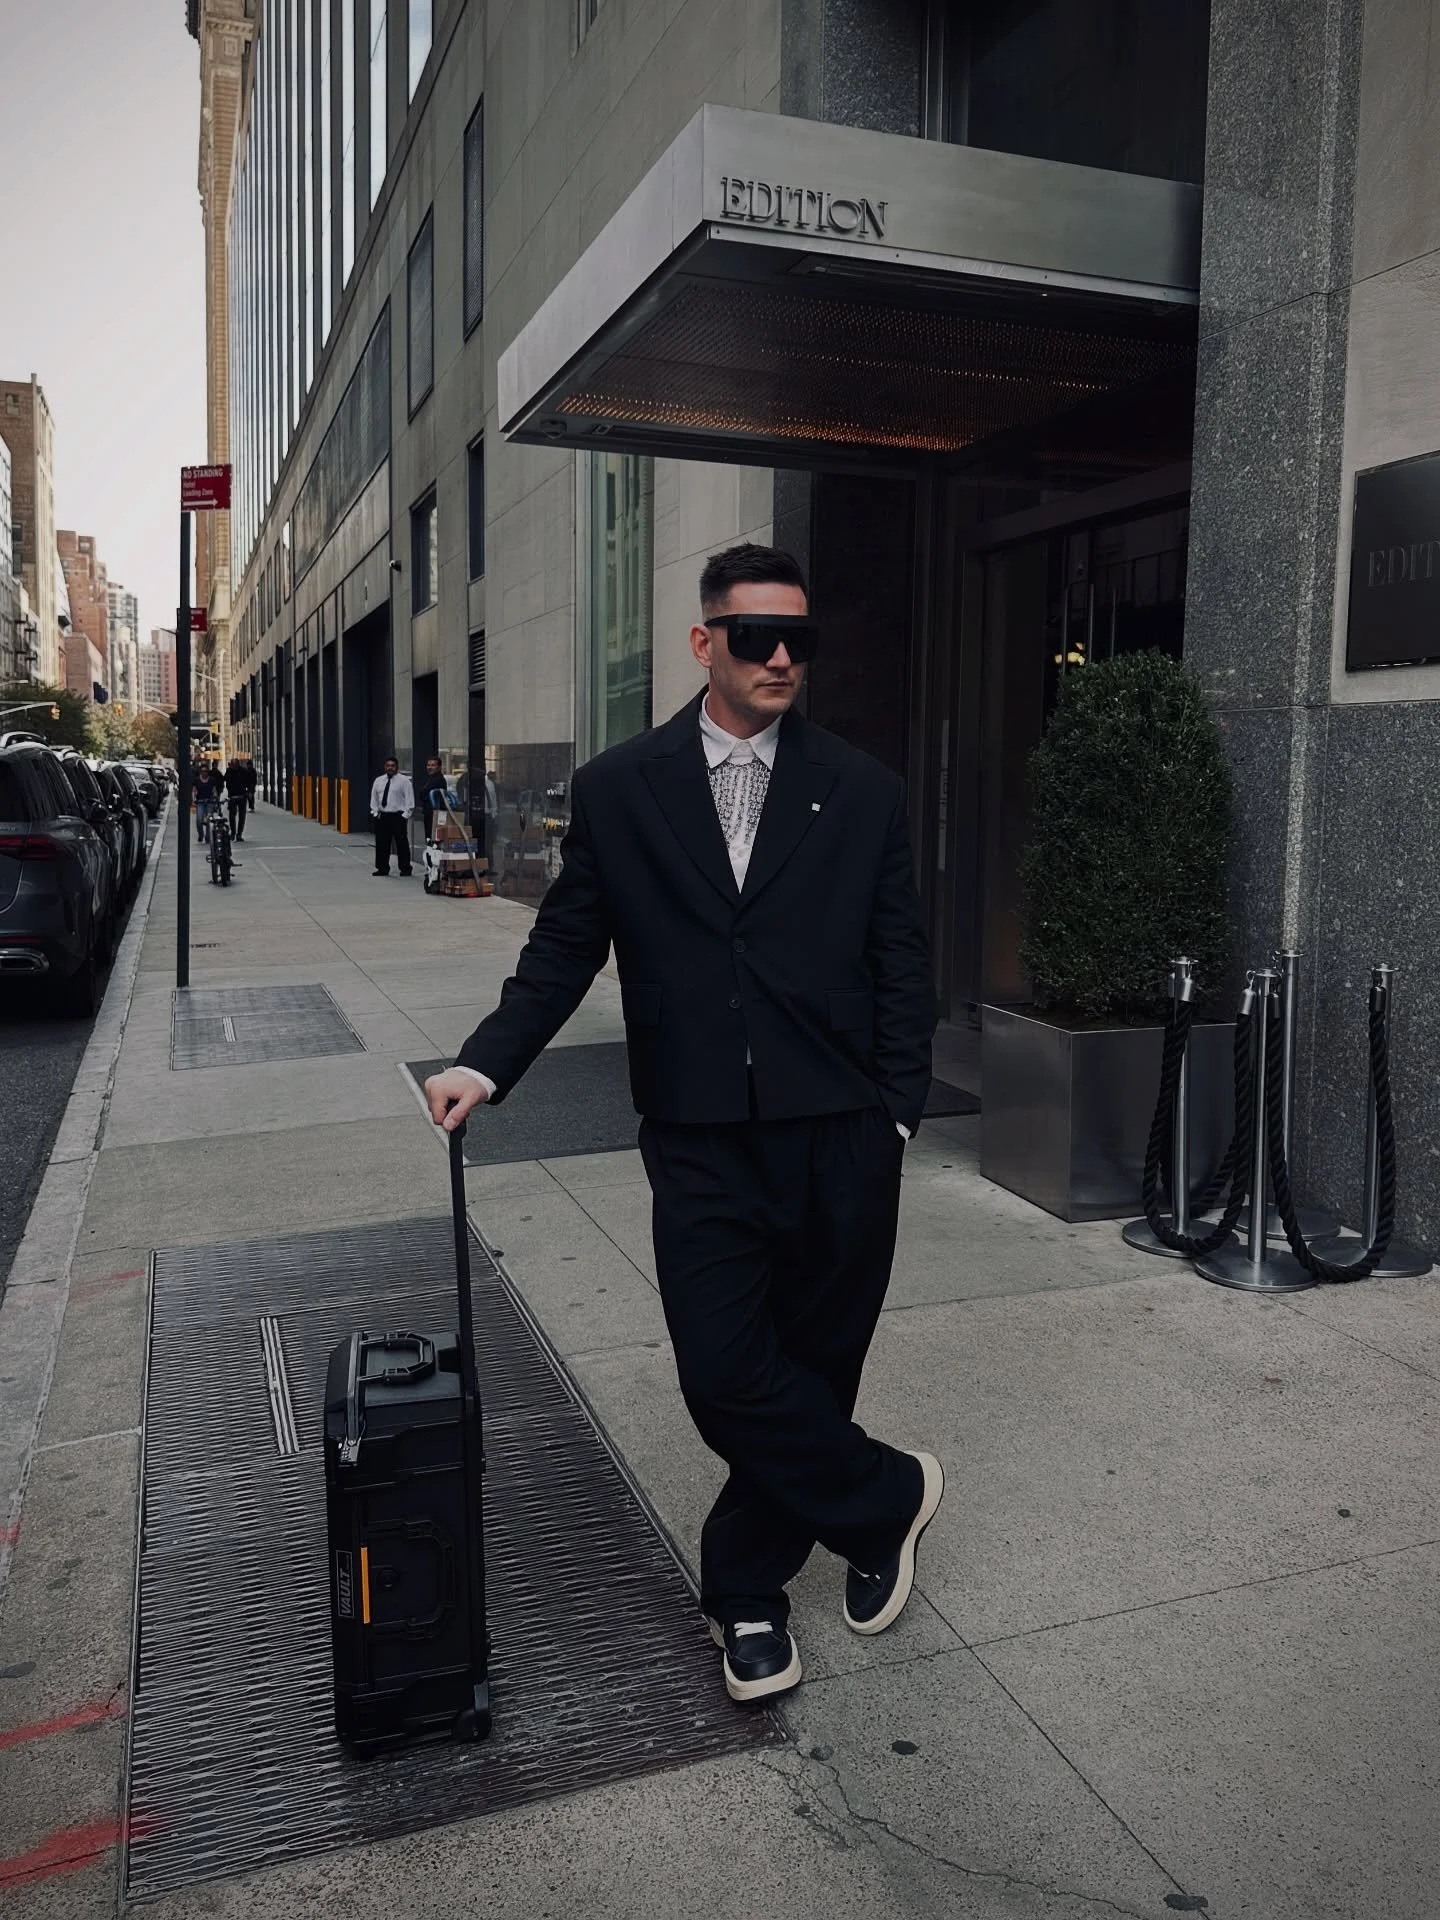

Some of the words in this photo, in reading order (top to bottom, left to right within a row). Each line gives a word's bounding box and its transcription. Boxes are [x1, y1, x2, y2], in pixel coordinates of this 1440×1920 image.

[717, 177, 889, 239] EDITION
[183, 470, 192, 478] NO
[193, 468, 223, 479] STANDING
[339, 1567, 352, 1615] VAULT
